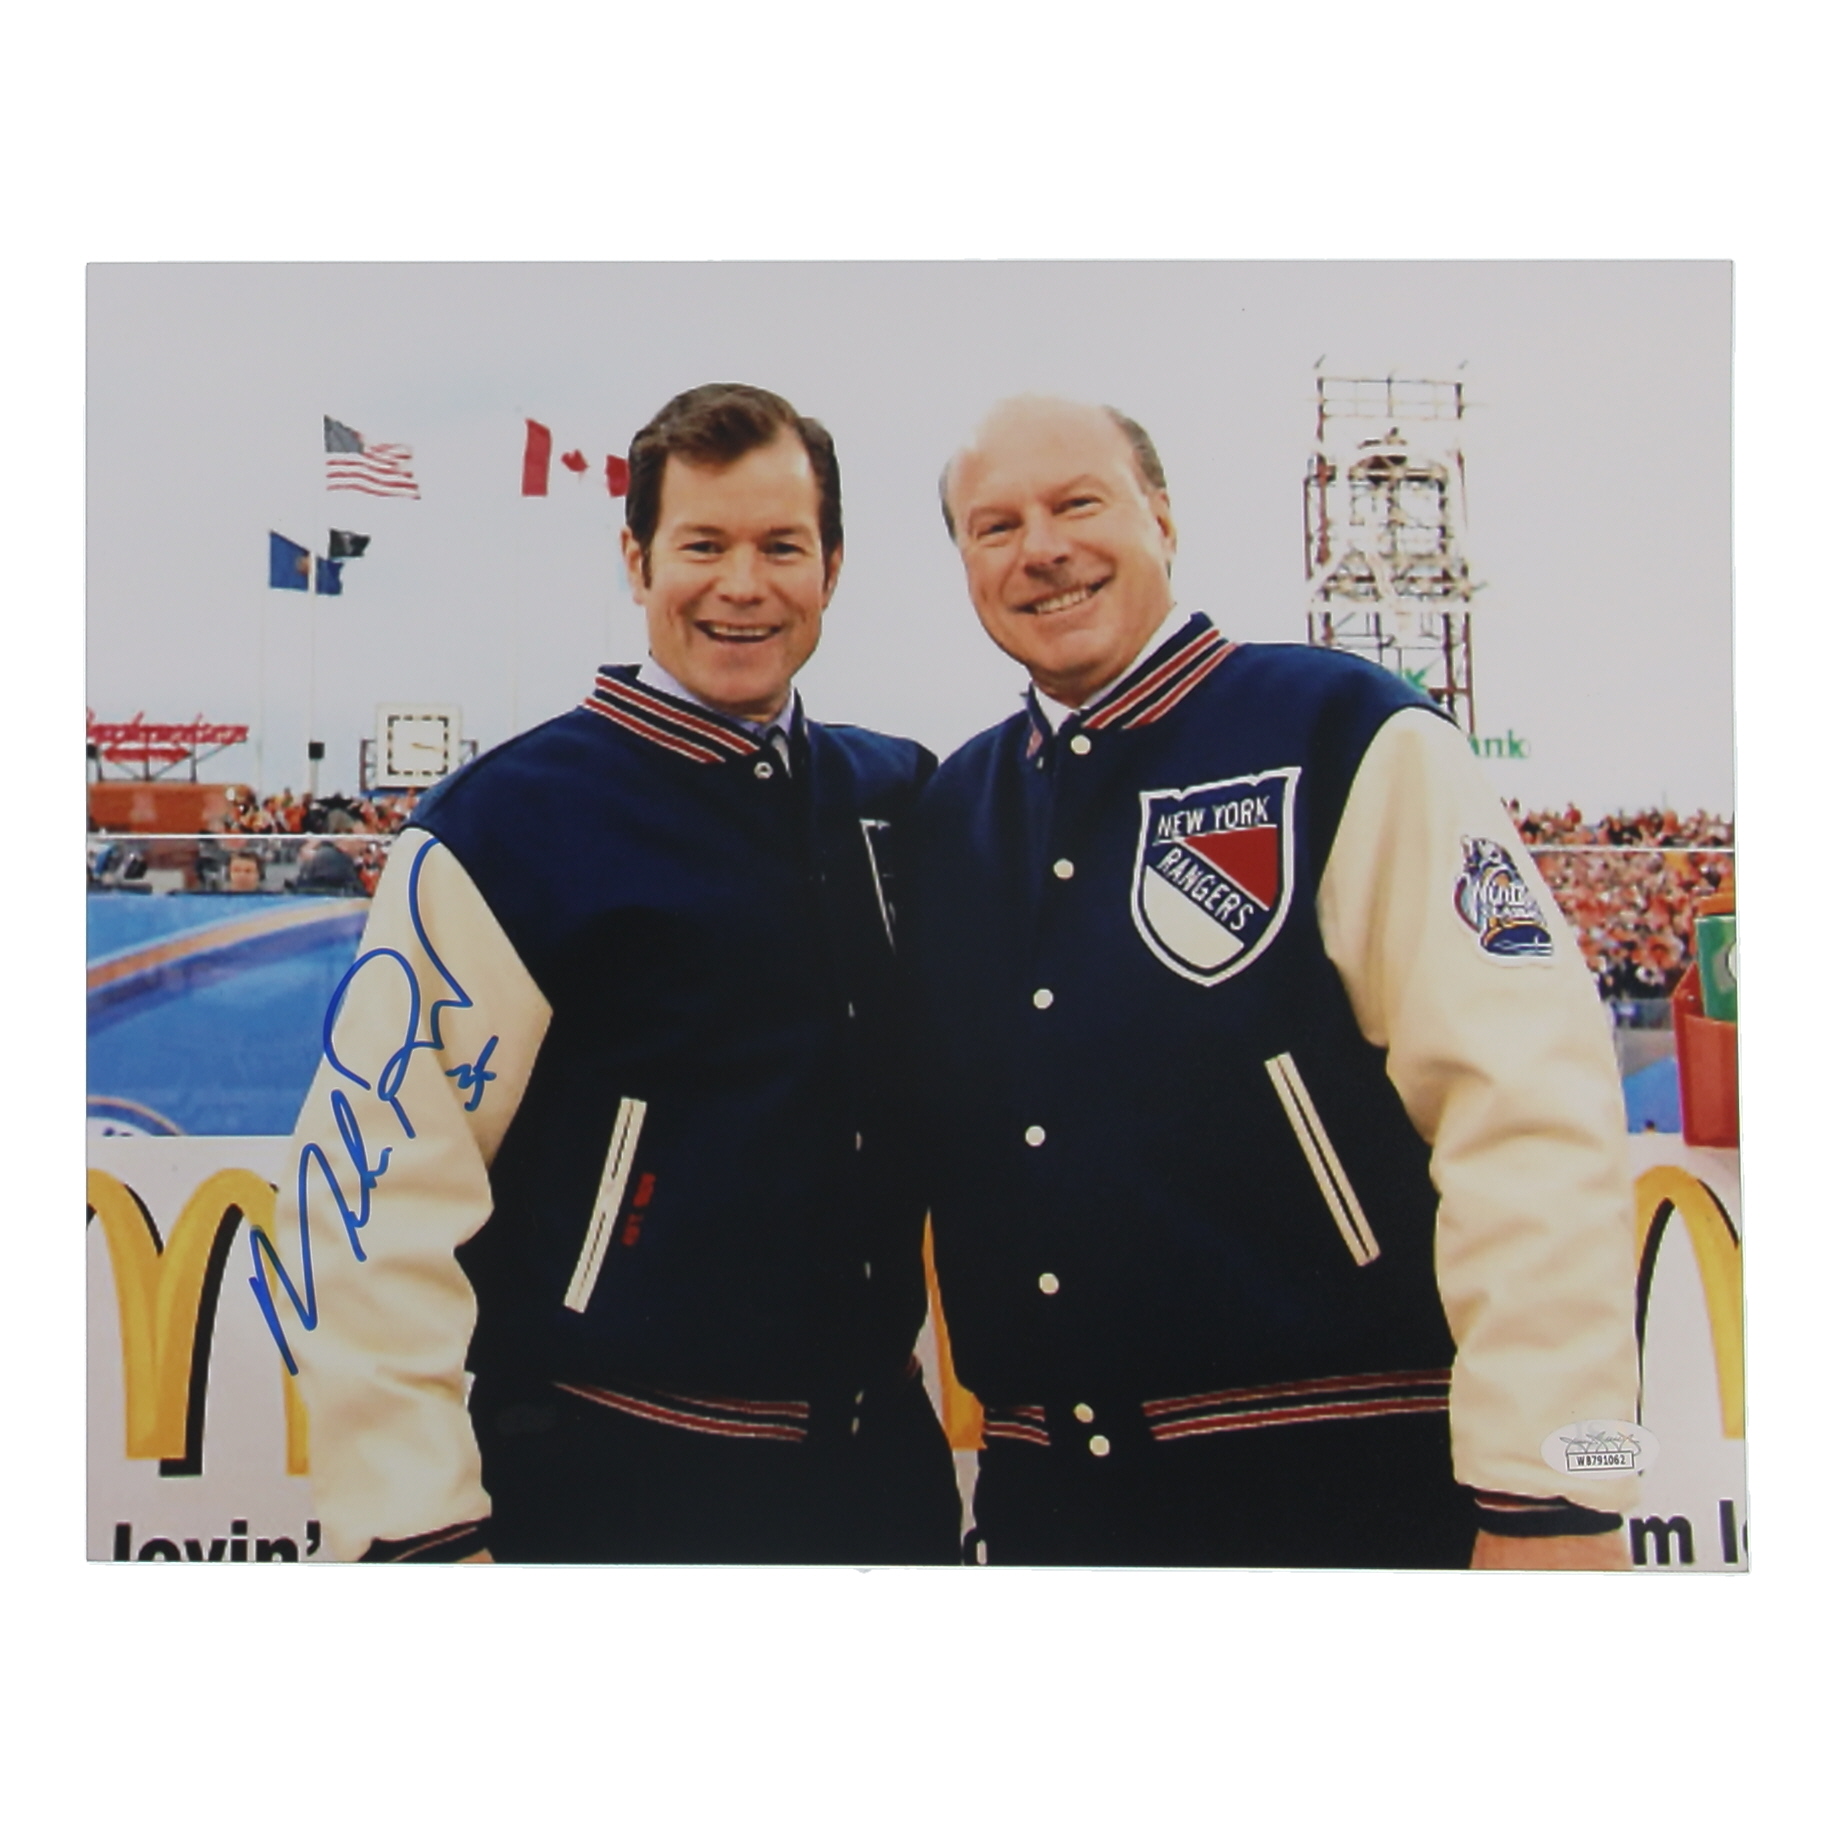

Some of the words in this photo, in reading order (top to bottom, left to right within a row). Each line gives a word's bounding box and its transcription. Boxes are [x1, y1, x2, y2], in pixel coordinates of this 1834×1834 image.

[1157, 808, 1206, 838] NEW
[1212, 795, 1270, 828] YORK
[1155, 847, 1255, 931] RANGERS
